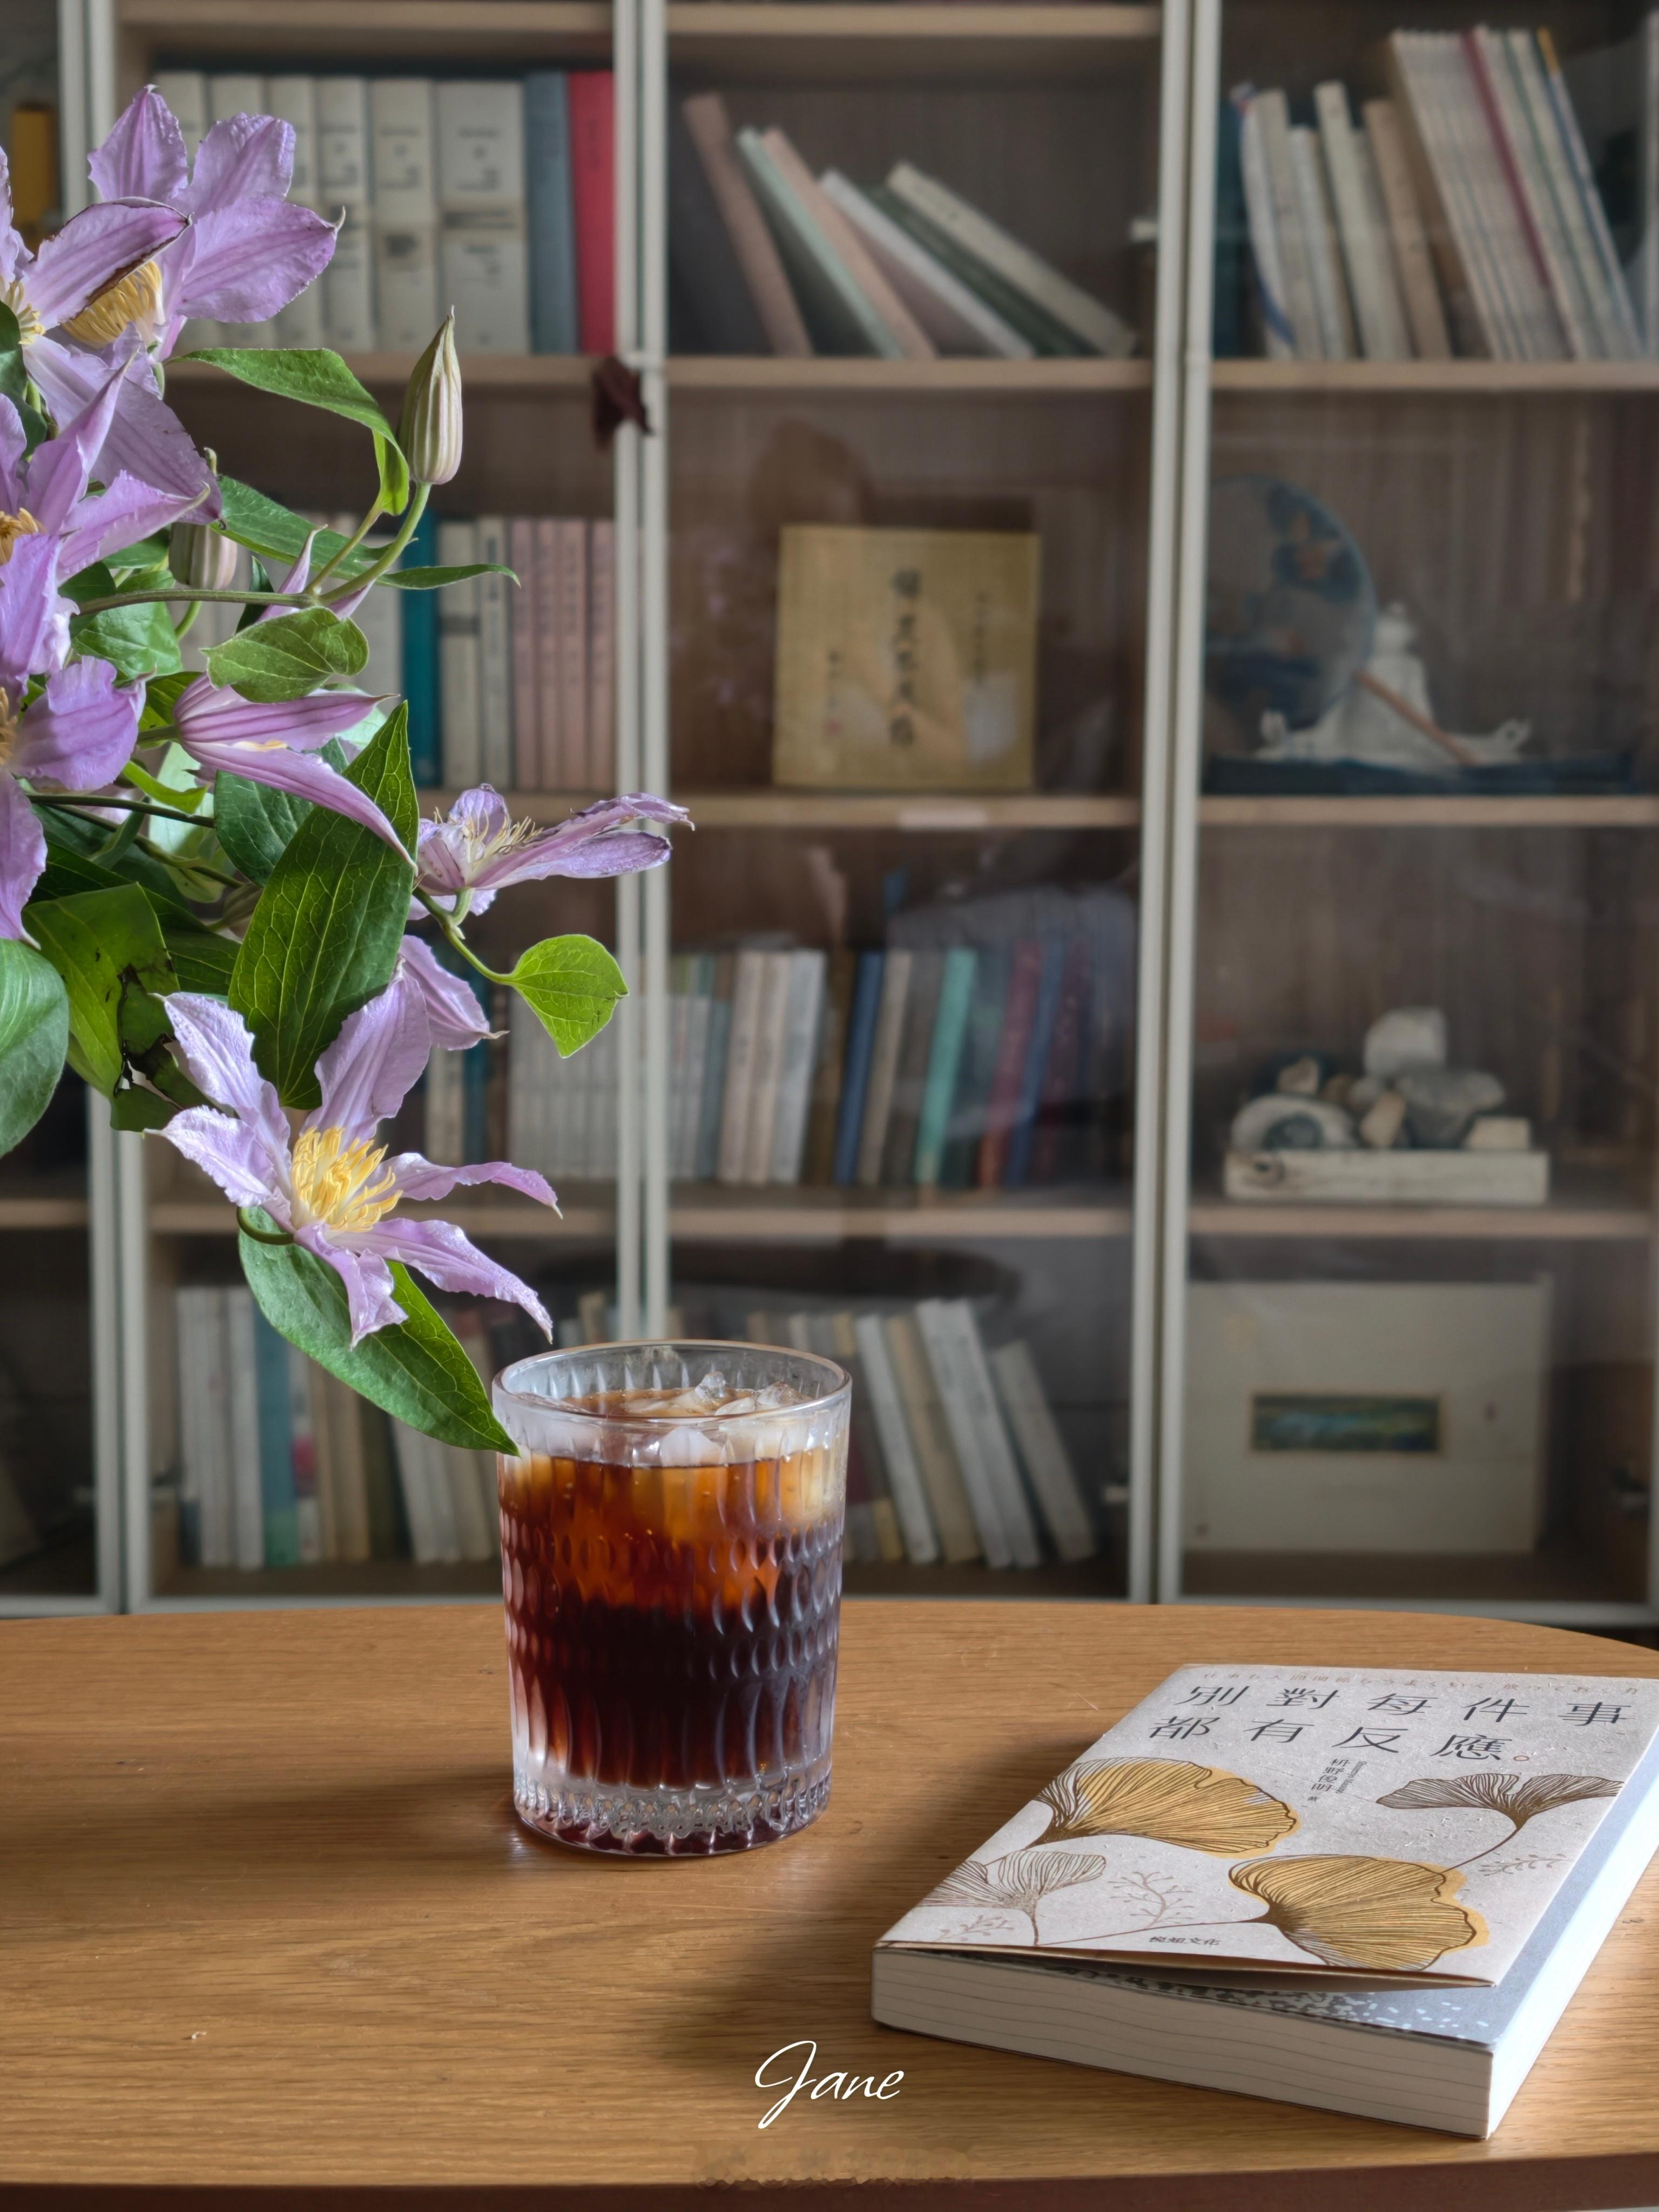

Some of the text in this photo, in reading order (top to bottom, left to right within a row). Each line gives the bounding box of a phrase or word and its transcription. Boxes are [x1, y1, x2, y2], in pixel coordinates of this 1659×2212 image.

[1173, 1685, 1634, 1727] 別對每件事
